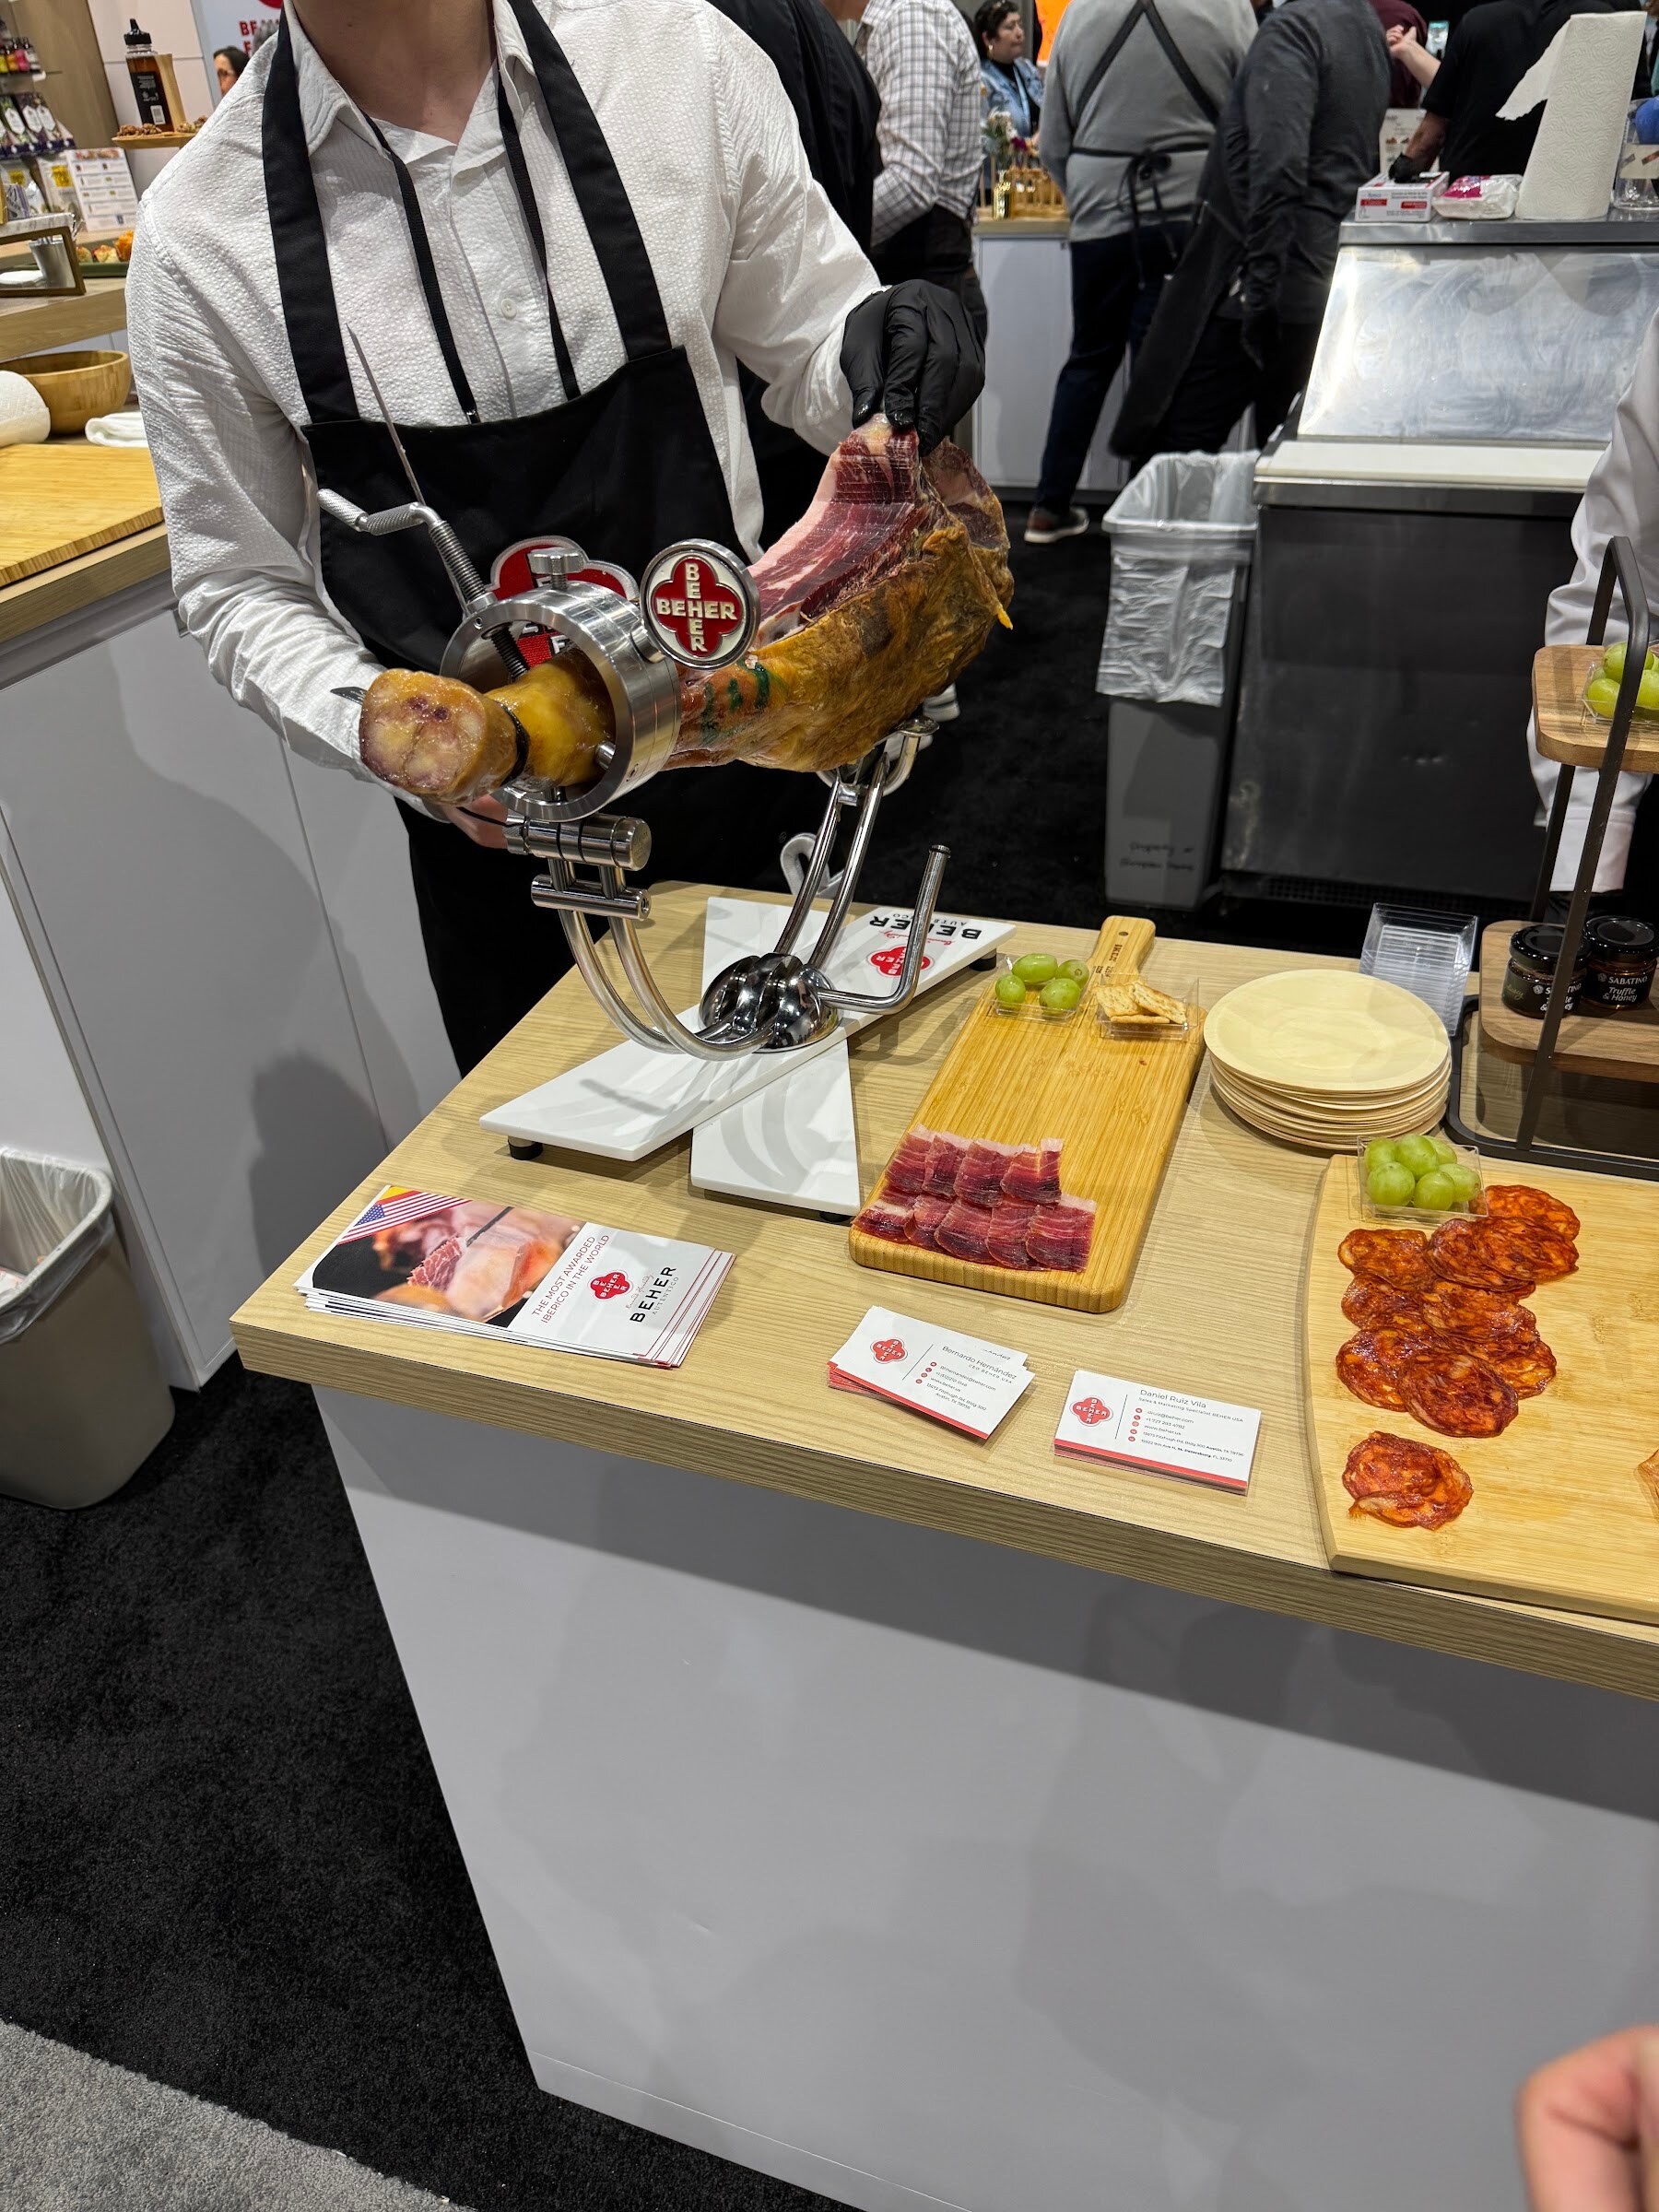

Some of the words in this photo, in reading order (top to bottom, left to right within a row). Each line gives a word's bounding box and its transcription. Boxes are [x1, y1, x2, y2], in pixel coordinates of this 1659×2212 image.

[655, 597, 737, 619] BEHER
[685, 562, 708, 652] BEHER
[869, 915, 982, 940] BEER
[1607, 975, 1648, 985] SABATINO
[1608, 986, 1636, 994] Truffle
[1610, 993, 1638, 1002] Honey
[532, 1299, 549, 1315] THE
[546, 1276, 566, 1300] MOST
[563, 1236, 595, 1277] AWARDED
[541, 1290, 570, 1324] IBERICO
[566, 1280, 577, 1290] IN
[572, 1264, 589, 1279] THE
[584, 1235, 610, 1264] WORLD
[593, 1280, 628, 1291] BEHER
[600, 1274, 620, 1297] BEHER
[629, 1266, 677, 1323] BEHER
[652, 1277, 679, 1315] AUTENTICO
[942, 1346, 976, 1363] Bernardo
[976, 1359, 1018, 1380] Hernández
[1140, 1389, 1168, 1400] Daniel
[1170, 1395, 1189, 1405] Ruiz
[1190, 1399, 1206, 1408] Vila
[1158, 1401, 1184, 1411] Marketing
[1185, 1406, 1211, 1416] Specialist
